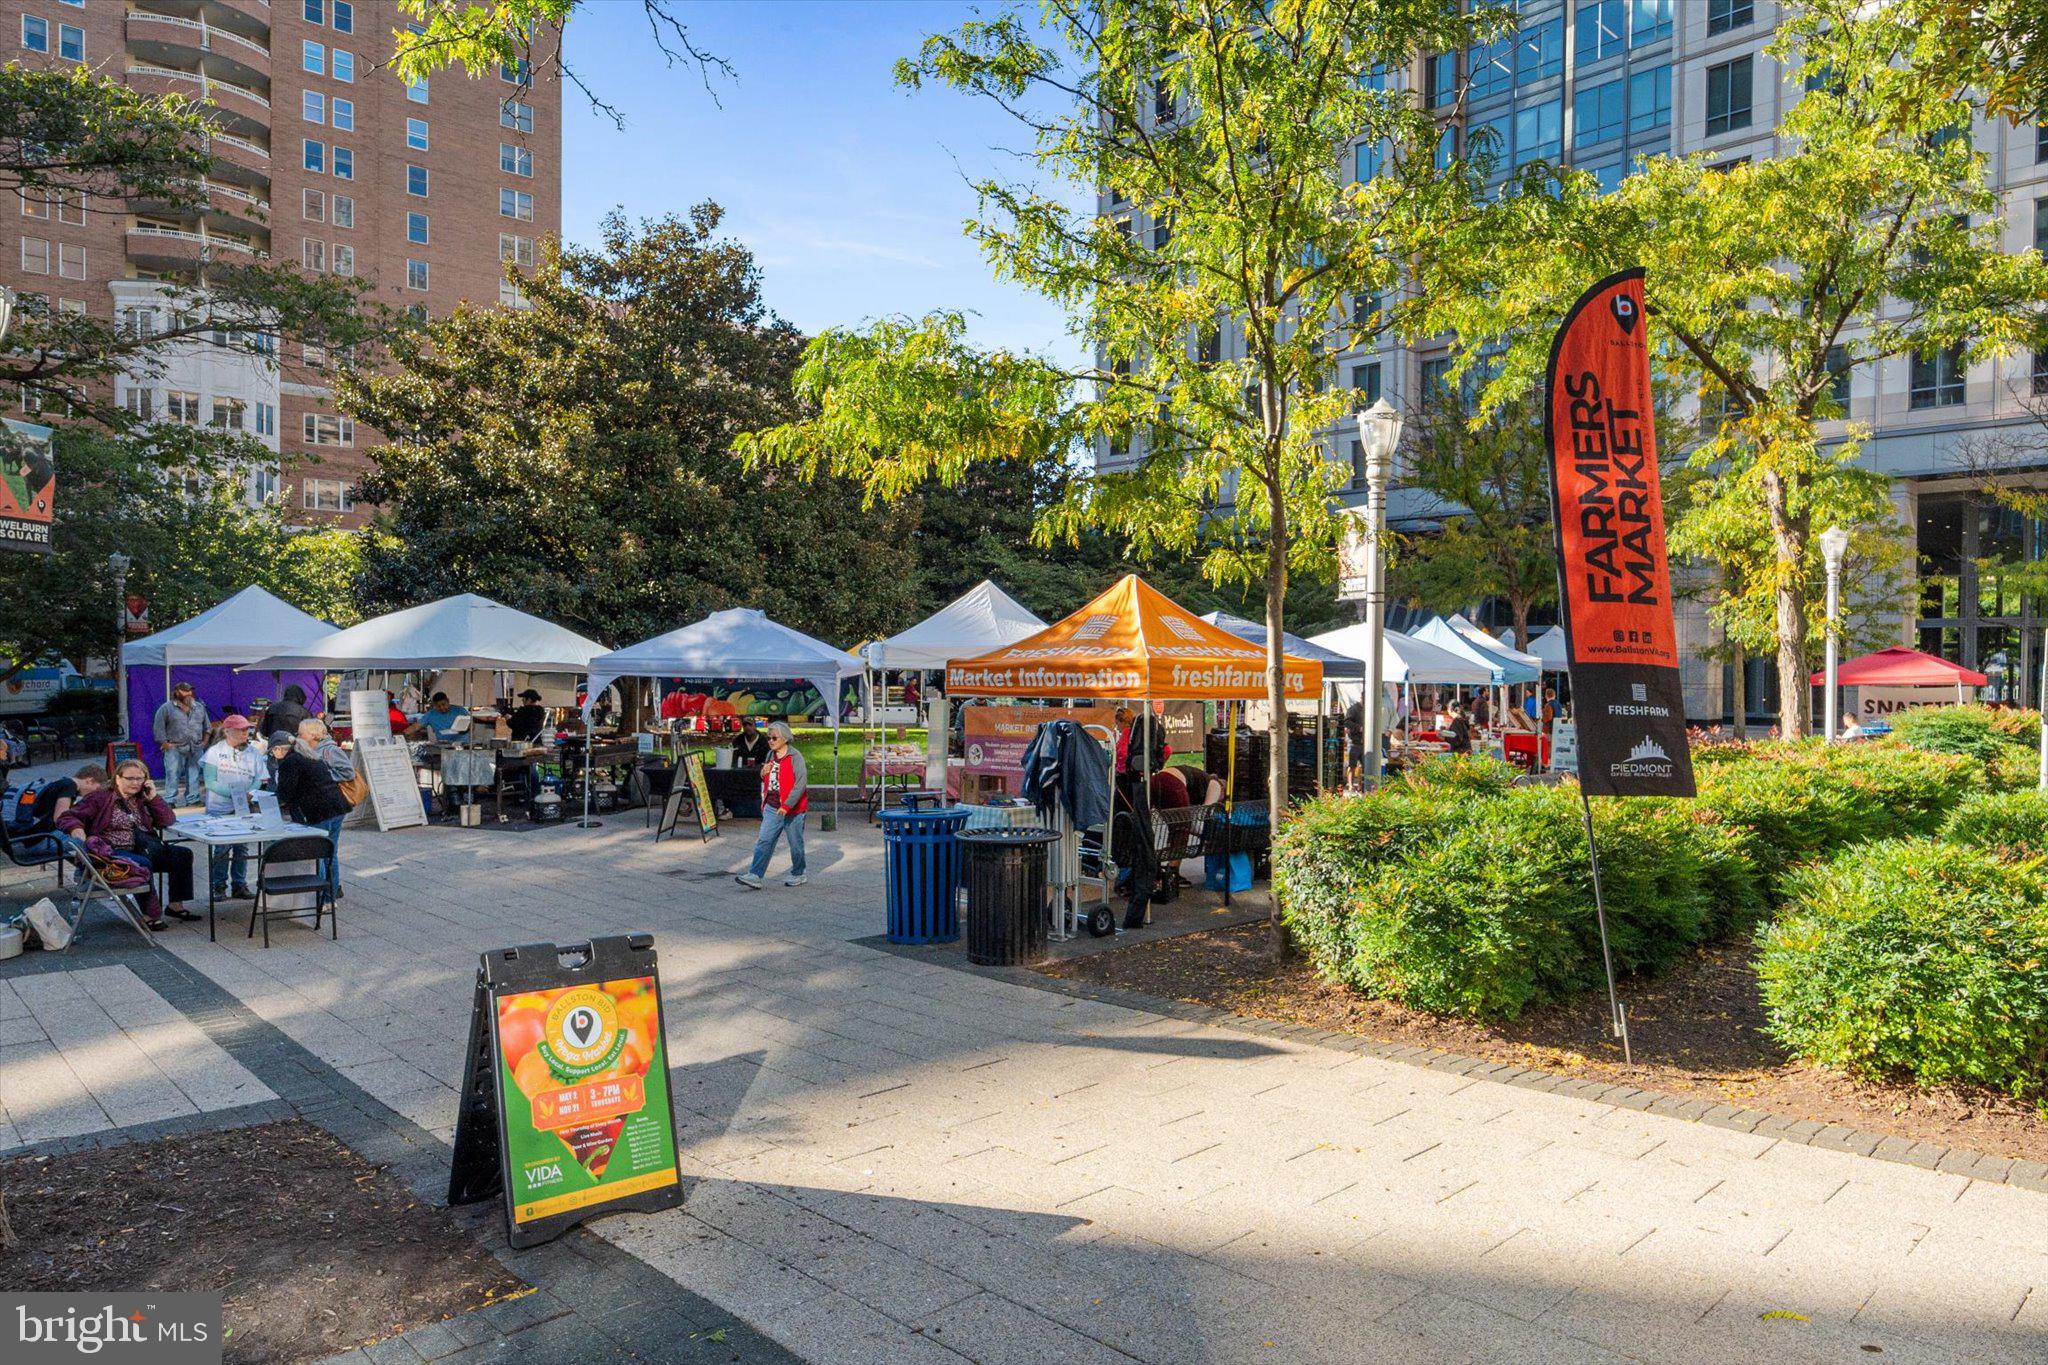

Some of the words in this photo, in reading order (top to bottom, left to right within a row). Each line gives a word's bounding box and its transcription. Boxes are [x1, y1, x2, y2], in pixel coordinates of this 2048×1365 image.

[1564, 371, 1624, 603] FARMERS
[1605, 398, 1657, 605] MARKET
[0, 520, 49, 534] WELBURN
[0, 529, 49, 543] SQUARE
[950, 667, 1014, 687] Market
[1018, 667, 1141, 689] Information
[1171, 664, 1304, 692] freshfarmrg
[1608, 704, 1670, 717] FRESHFARM
[995, 724, 1024, 733] MARKET
[1610, 763, 1674, 773] PIEDMONT
[552, 993, 597, 1021] BALLSTON
[597, 999, 612, 1013] BID
[565, 1066, 591, 1075] Support
[558, 1092, 573, 1102] MAY
[590, 1088, 596, 1100] 3
[603, 1084, 620, 1097] 7PM
[559, 1105, 573, 1115] NOV
[525, 1163, 563, 1183] VIDA
